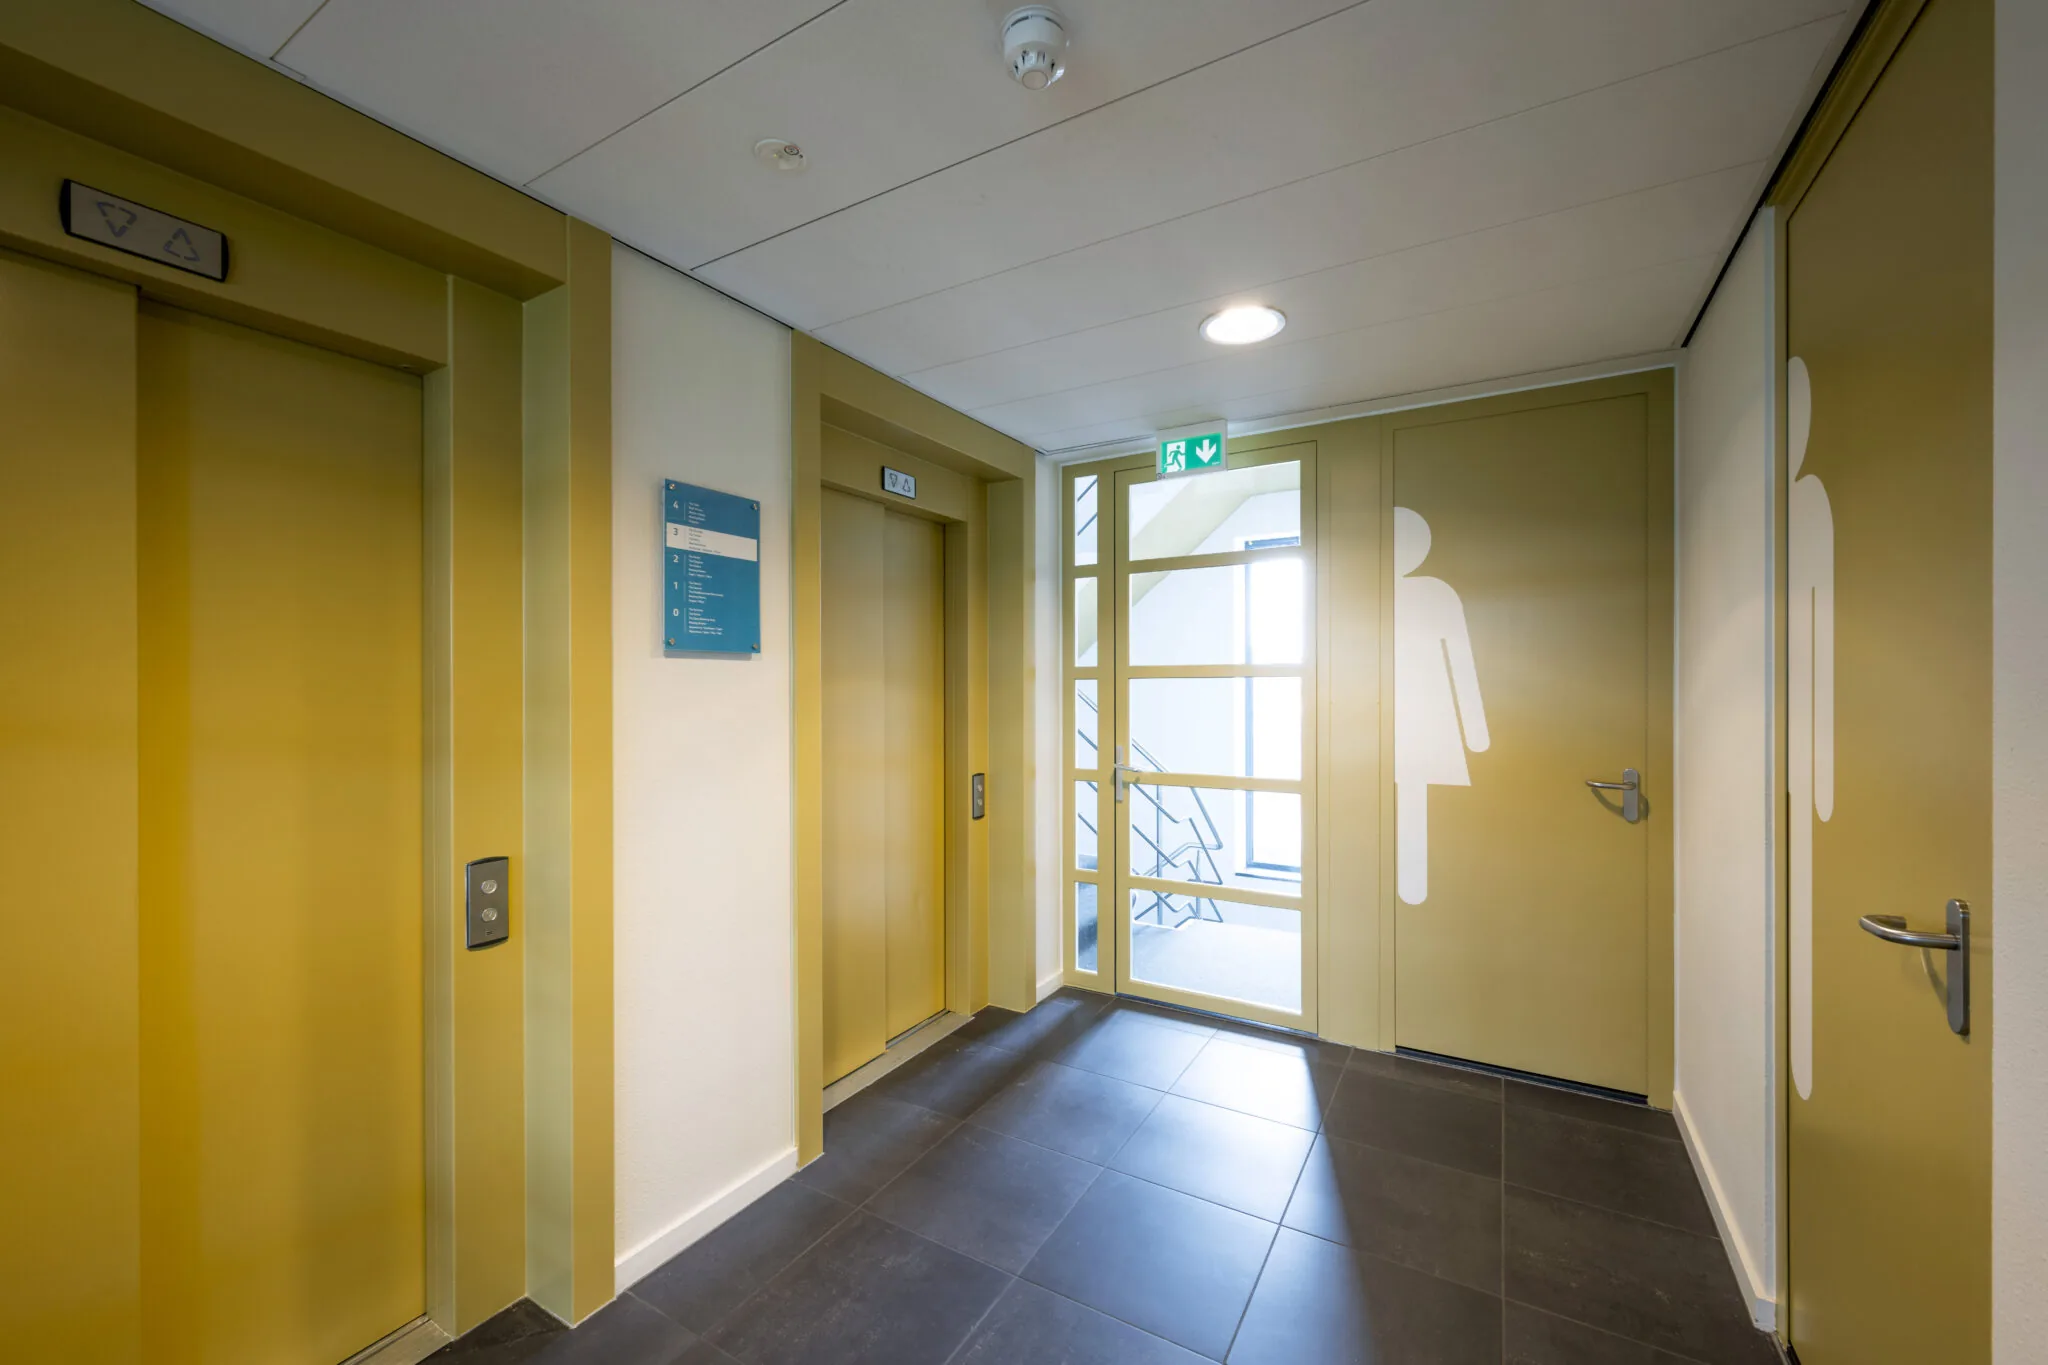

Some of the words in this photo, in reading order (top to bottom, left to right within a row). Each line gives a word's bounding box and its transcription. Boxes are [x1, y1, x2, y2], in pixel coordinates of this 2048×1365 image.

[673, 500, 679, 509] 4
[673, 527, 679, 536] 3
[673, 554, 679, 563] 2
[673, 581, 678, 590] 1
[673, 608, 679, 617] 0
